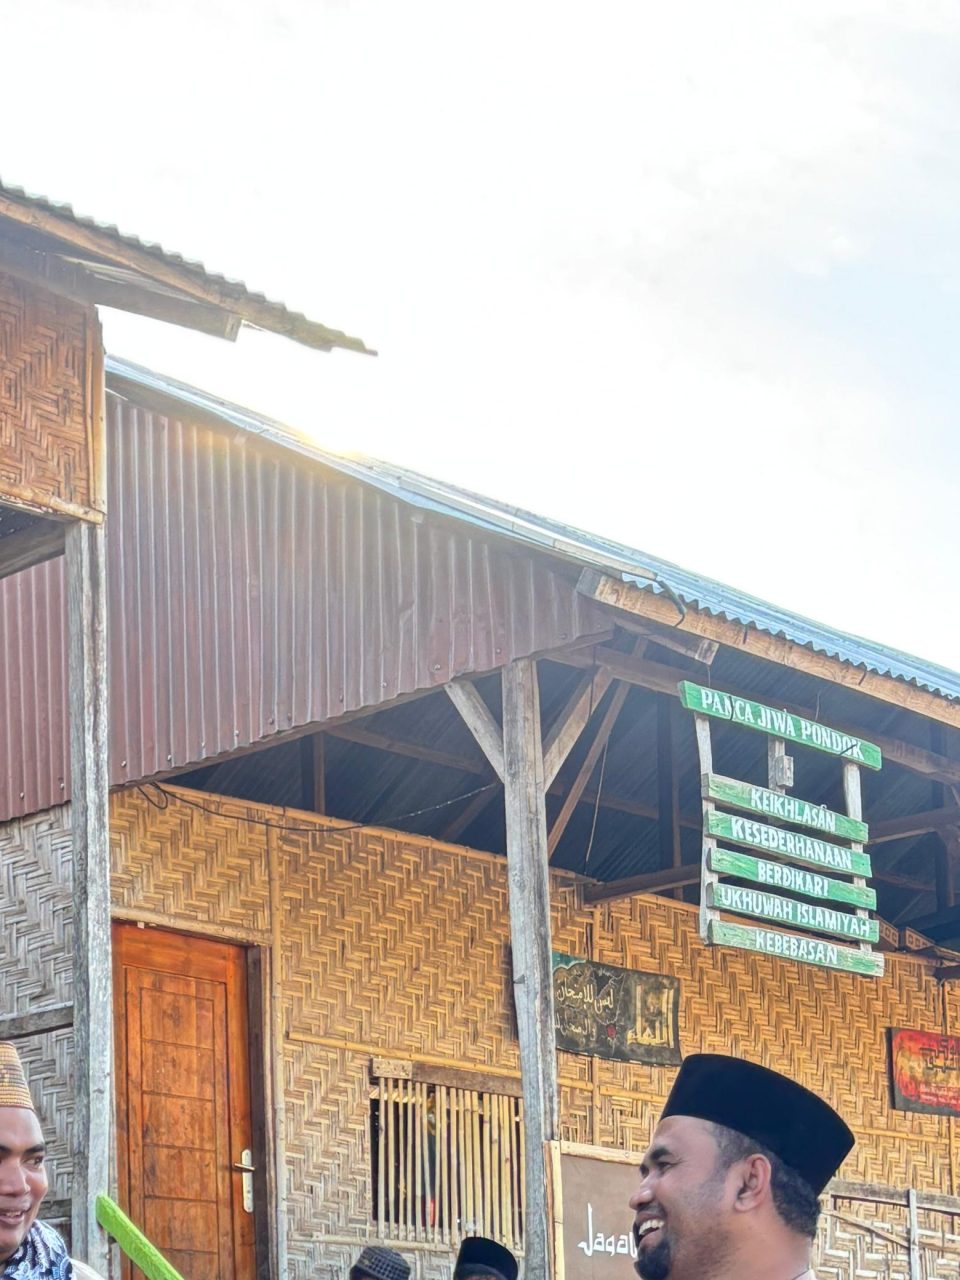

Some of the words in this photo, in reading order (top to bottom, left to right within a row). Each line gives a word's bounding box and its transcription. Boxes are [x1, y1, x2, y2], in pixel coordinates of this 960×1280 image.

[701, 688, 753, 724] PANCA
[758, 707, 796, 737] JIWA
[802, 721, 865, 760] PONDOK
[751, 787, 836, 832] KEIKHLASAN
[731, 818, 853, 870] KESEDERHANAAN
[757, 861, 829, 896] BERDIKARI
[721, 888, 792, 921] UKHUWAH
[797, 903, 871, 936] ISLAMIYAH
[755, 930, 839, 964] KEBEBASAN
